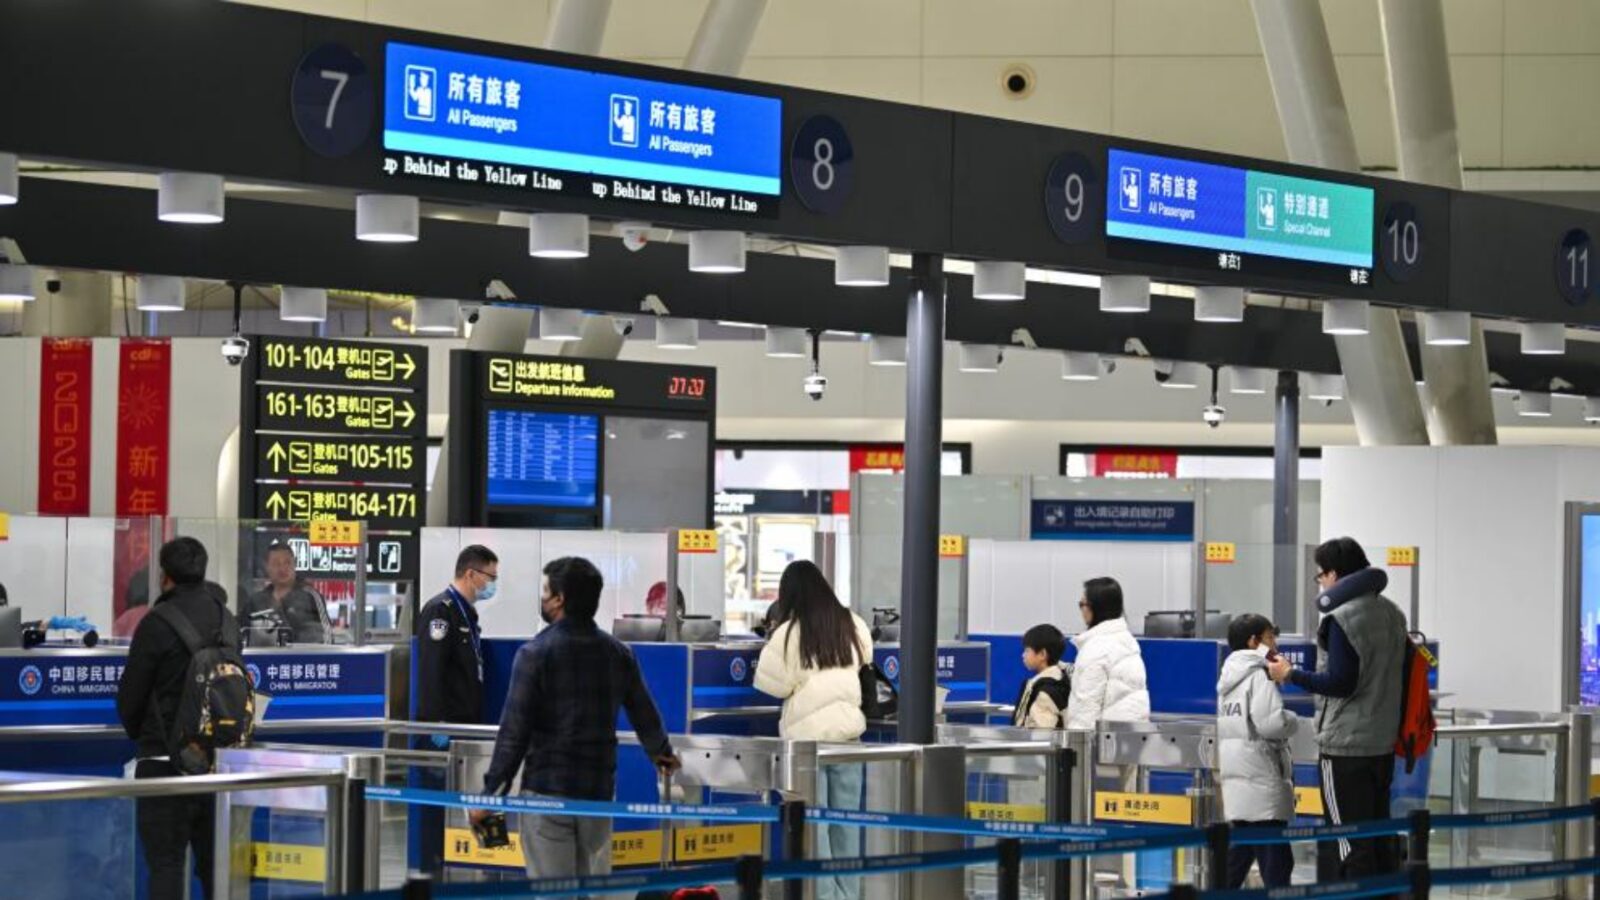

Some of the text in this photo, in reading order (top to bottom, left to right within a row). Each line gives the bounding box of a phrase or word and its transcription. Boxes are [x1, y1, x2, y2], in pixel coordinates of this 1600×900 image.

[320, 69, 349, 129] 7
[448, 72, 521, 110] 所有旅客
[447, 107, 518, 133] All Passengers
[649, 100, 716, 136] 所有旅客
[648, 134, 713, 159] All Passengers
[404, 156, 450, 178] Behind
[456, 162, 479, 180] the
[484, 165, 528, 186] Yellow
[532, 171, 562, 190] Line
[812, 137, 834, 190] 8
[592, 180, 758, 212] up Behind the Yellow Line
[1065, 173, 1084, 222] 9
[1148, 171, 1198, 201] 所有旅客
[1148, 201, 1196, 221] All Passengers
[1284, 190, 1329, 219] 特别通道
[1389, 219, 1418, 265] 10
[1567, 246, 1588, 289] 11
[265, 343, 371, 370] 101-104 登机口
[345, 366, 371, 379] Gates
[515, 361, 585, 382] 出发航班信息
[515, 380, 615, 399] Departure Information
[266, 392, 371, 418] 161-163 登机口
[345, 415, 371, 427] Gates
[313, 443, 413, 469] 登机口 105-115
[313, 461, 338, 474] Gates
[312, 511, 337, 521] Gates
[313, 492, 416, 517] 登机口 164-171
[266, 663, 341, 680] 中国移民管理
[51, 684, 76, 695] CHINA
[269, 680, 338, 691] CHINA IMMIGRATION
